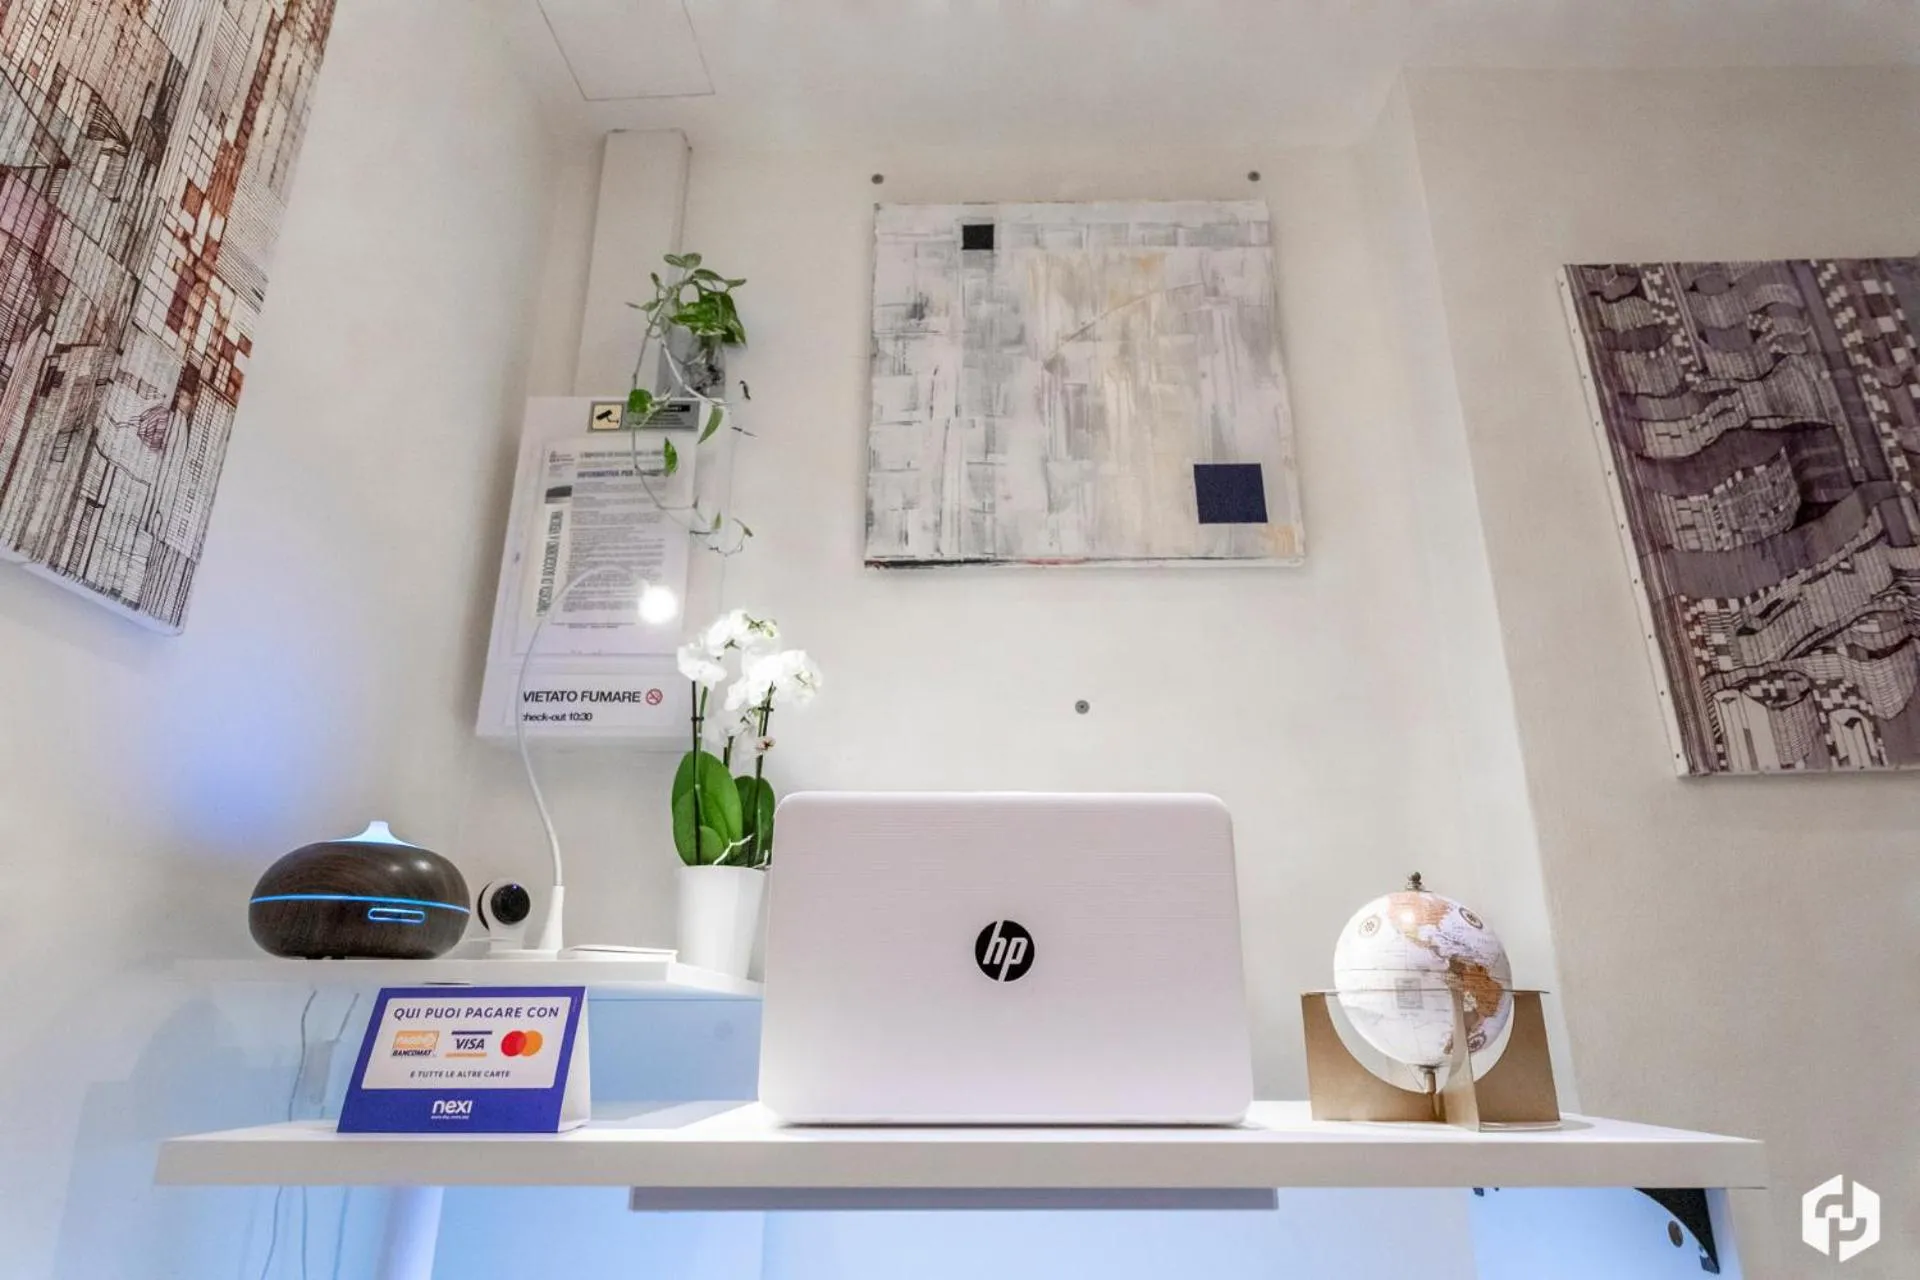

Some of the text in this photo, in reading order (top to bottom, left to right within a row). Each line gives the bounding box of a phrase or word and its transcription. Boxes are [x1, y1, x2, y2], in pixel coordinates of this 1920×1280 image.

[523, 690, 641, 703] VIETATO FUMARE
[568, 712, 593, 722] 10:30
[980, 920, 1030, 981] hp
[394, 1007, 559, 1021] QUI PUOI PAGARE CON
[456, 1038, 485, 1050] VISA
[418, 1070, 445, 1078] TUTTE
[445, 1070, 456, 1078] LE
[456, 1070, 483, 1078] ALTRE
[483, 1070, 511, 1078] CARTE
[432, 1100, 473, 1114] nexi
